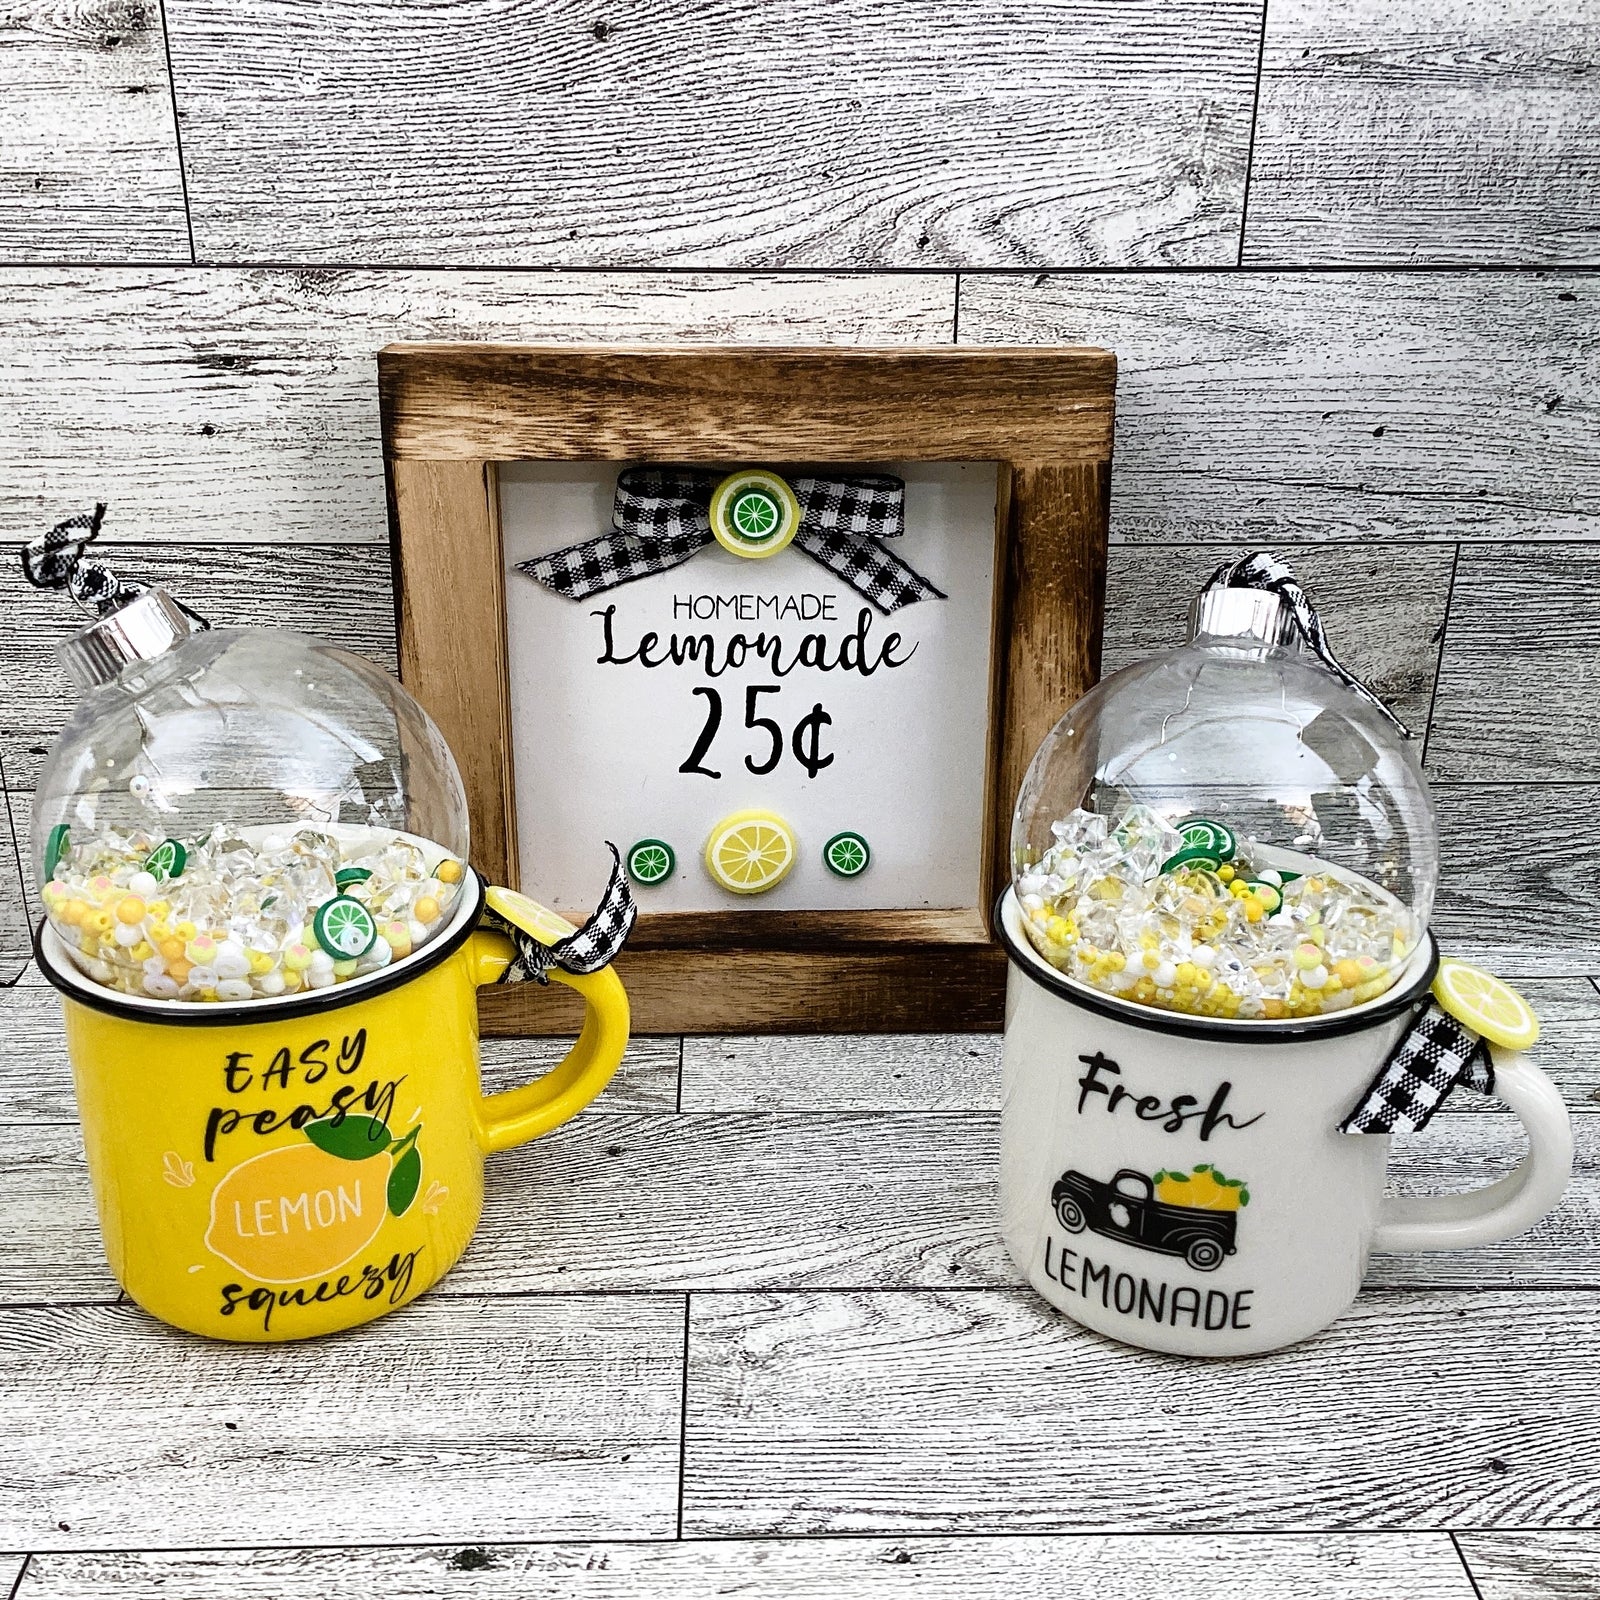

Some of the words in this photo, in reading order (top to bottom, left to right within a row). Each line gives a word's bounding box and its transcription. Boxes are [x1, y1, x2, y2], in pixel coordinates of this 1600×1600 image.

[590, 604, 919, 677] Lemonade
[673, 594, 838, 620] HOMEMADE
[678, 685, 835, 779] 25¢
[223, 1028, 367, 1093] EASY
[1078, 1051, 1266, 1142] Fresh
[204, 1074, 408, 1162] peasy
[234, 1179, 362, 1237] LEMON
[219, 1245, 425, 1331] squeezy
[1044, 1236, 1254, 1331] LEMONADE
